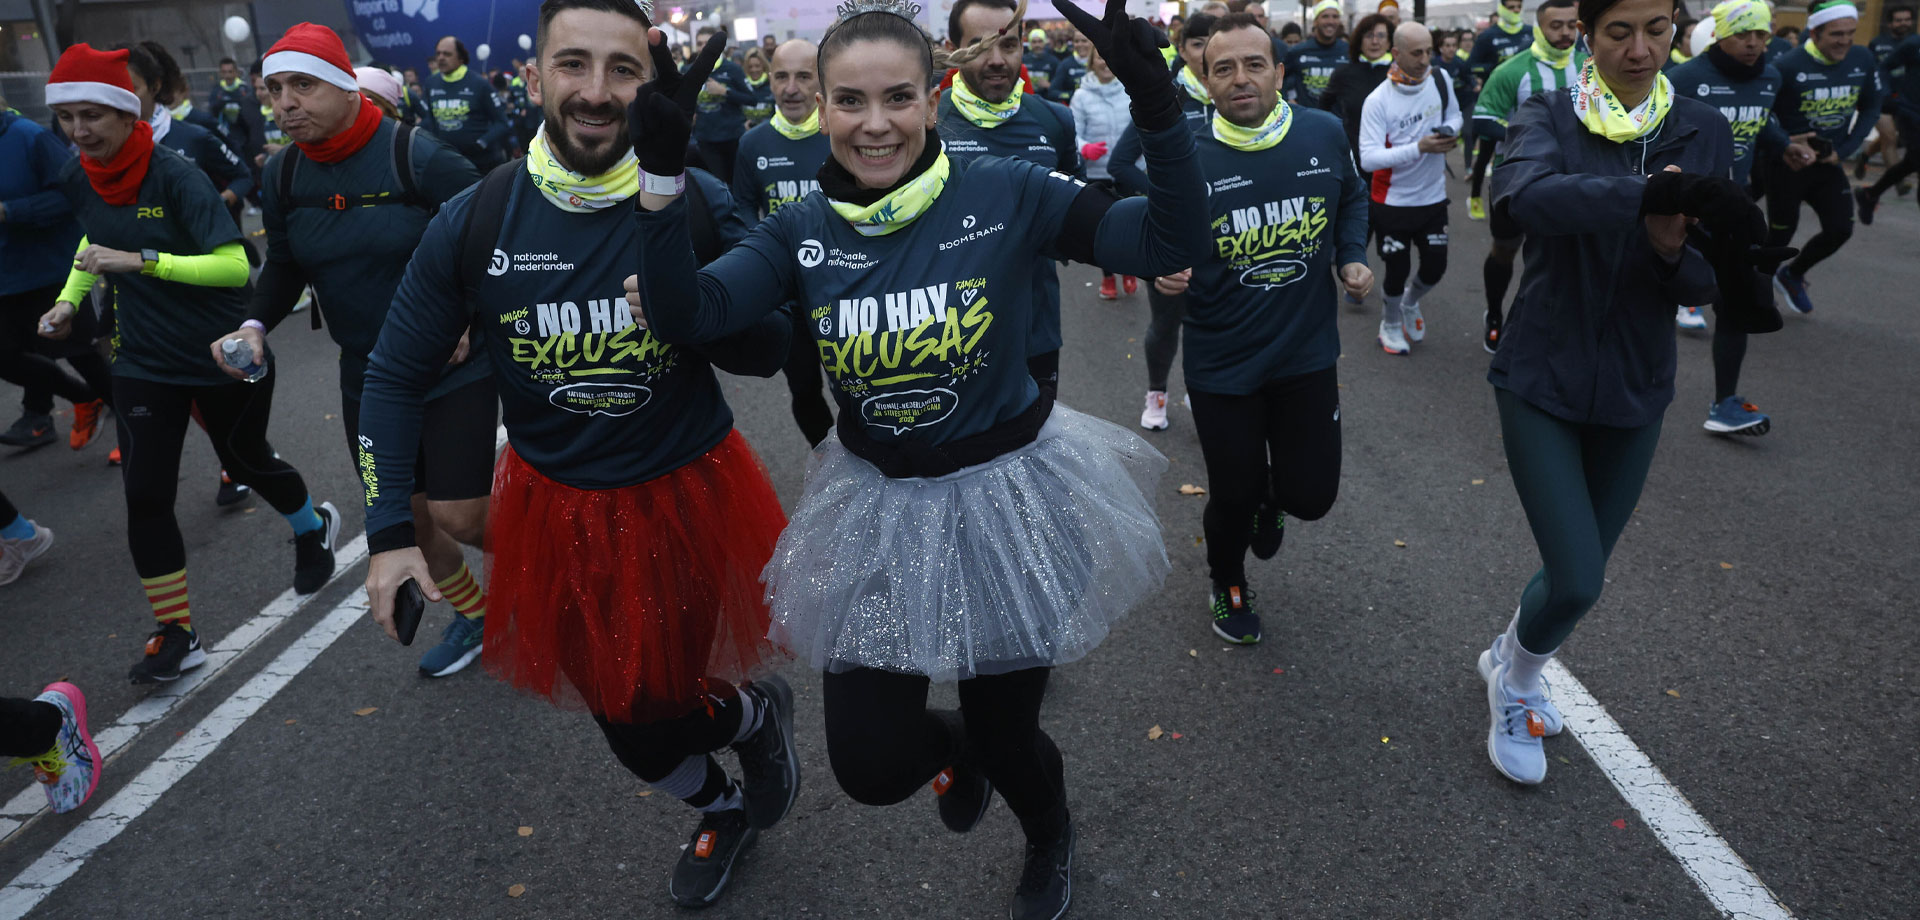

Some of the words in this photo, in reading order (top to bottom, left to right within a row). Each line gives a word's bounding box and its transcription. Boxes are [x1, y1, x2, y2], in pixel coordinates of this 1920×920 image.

[1213, 174, 1242, 187] nationale
[1214, 179, 1254, 193] nederlanden
[136, 206, 164, 219] RG
[1231, 206, 1262, 234] NO
[1264, 196, 1305, 226] HAY
[938, 222, 1005, 251] BOOMERANG
[1216, 208, 1328, 260] EXCUSAS
[513, 252, 559, 262] nationale
[513, 260, 574, 271] nederlanden
[955, 277, 987, 290] FAMILIA
[500, 306, 529, 324] AMIGOS
[536, 301, 581, 337] NO
[588, 297, 648, 334] HA
[838, 296, 879, 338] NO
[885, 282, 948, 333] HAY
[817, 296, 994, 380] EXCUSAS
